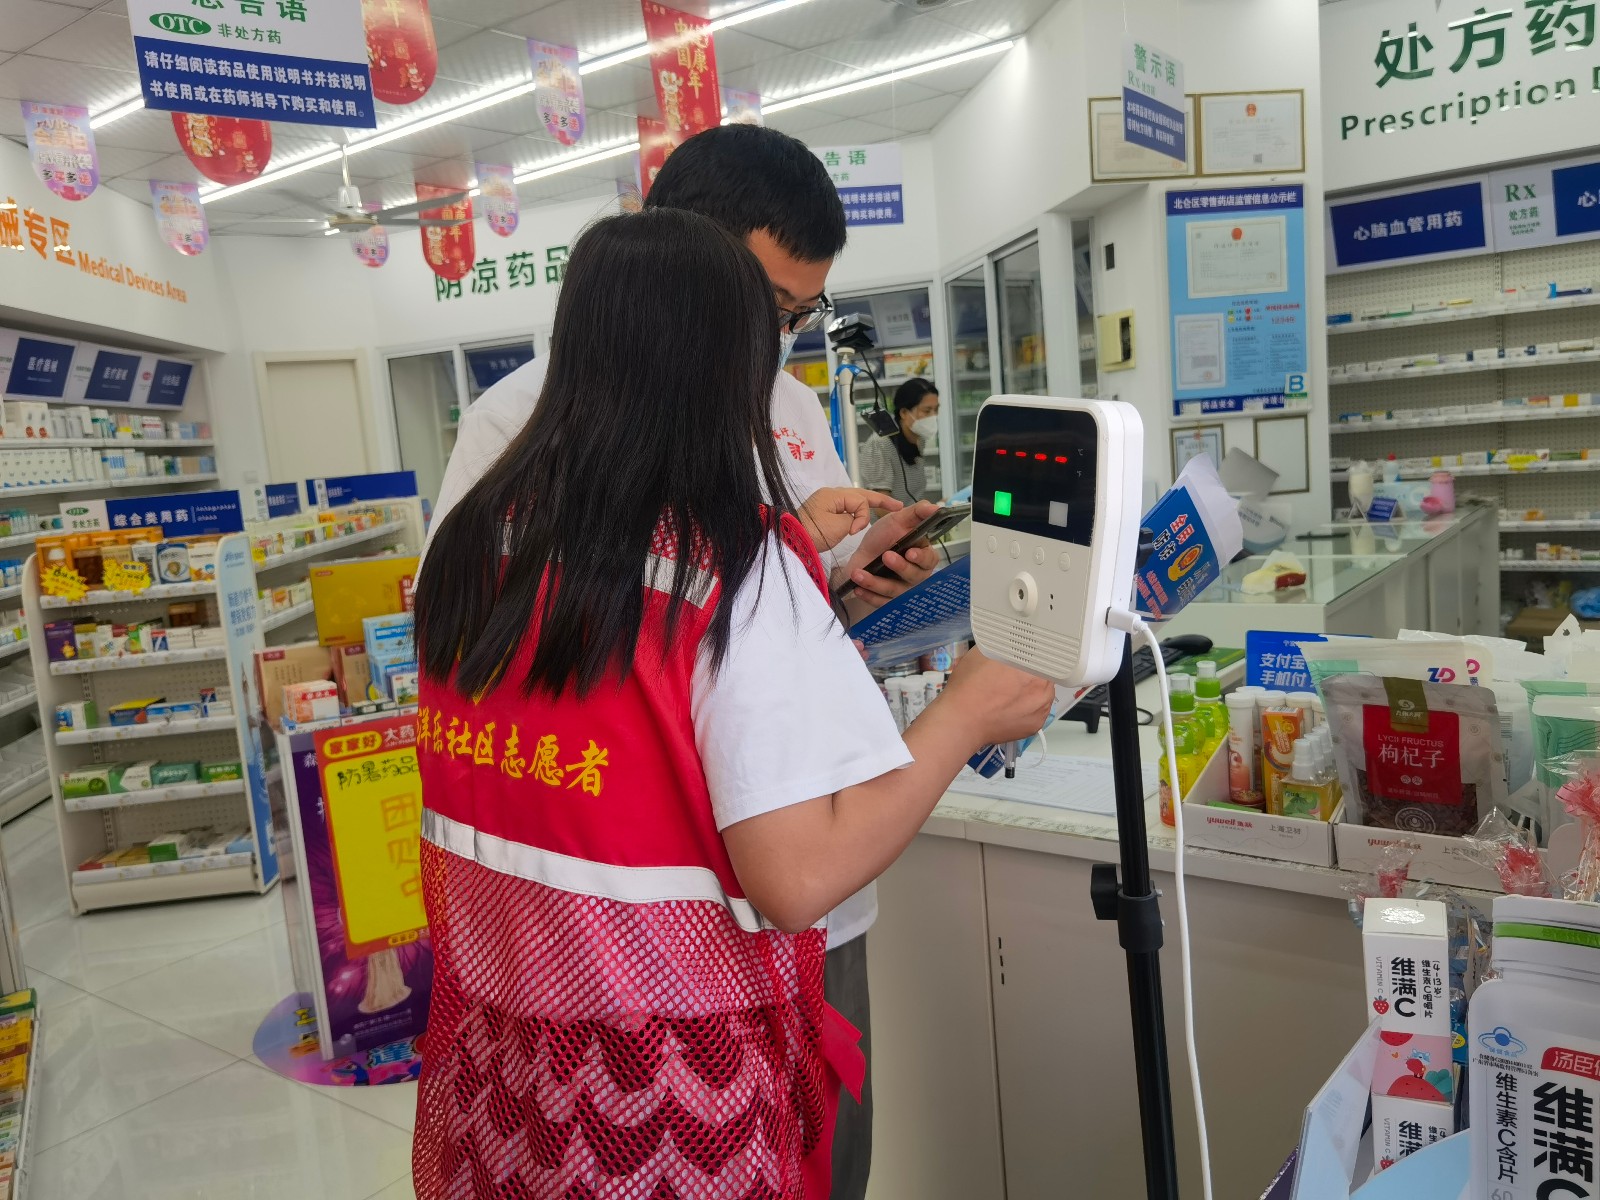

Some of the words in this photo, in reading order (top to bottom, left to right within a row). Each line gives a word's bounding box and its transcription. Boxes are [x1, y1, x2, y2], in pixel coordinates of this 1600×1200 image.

[157, 14, 205, 35] OTC
[217, 23, 283, 44] 非处方药
[1374, 0, 1595, 89] 处方药
[144, 51, 367, 91] 请仔细阅读药品使用说明书并按说明
[1133, 43, 1176, 88] 警示语
[149, 80, 365, 118] 书使用或在药师指导下购买和使用。
[1340, 80, 1576, 141] Prescription
[1505, 183, 1537, 203] Rx
[1577, 190, 1600, 208] 心
[1353, 210, 1463, 242] 心脑血管用药
[78, 250, 125, 286] Medical
[125, 266, 165, 297] Devices
[166, 280, 188, 303] Area
[1289, 374, 1305, 393] B
[113, 508, 190, 528] 综合类用药
[1259, 652, 1305, 670] 支付宝
[1427, 667, 1456, 683] ZD
[1259, 669, 1316, 689] 手机付
[1377, 743, 1446, 770] 枸杞子
[1401, 736, 1445, 749] FRUCTUS
[336, 755, 419, 791] 防暑药品
[1206, 815, 1236, 826] yuwell
[1375, 956, 1384, 987] VITAMIN
[1390, 956, 1417, 1018] 维满C
[1421, 959, 1434, 1019] 维生素C咀嚼片
[1383, 1117, 1391, 1147] VITAMIN
[1495, 1072, 1519, 1185] 维生素C含片
[1533, 1081, 1594, 1200] 维满C
